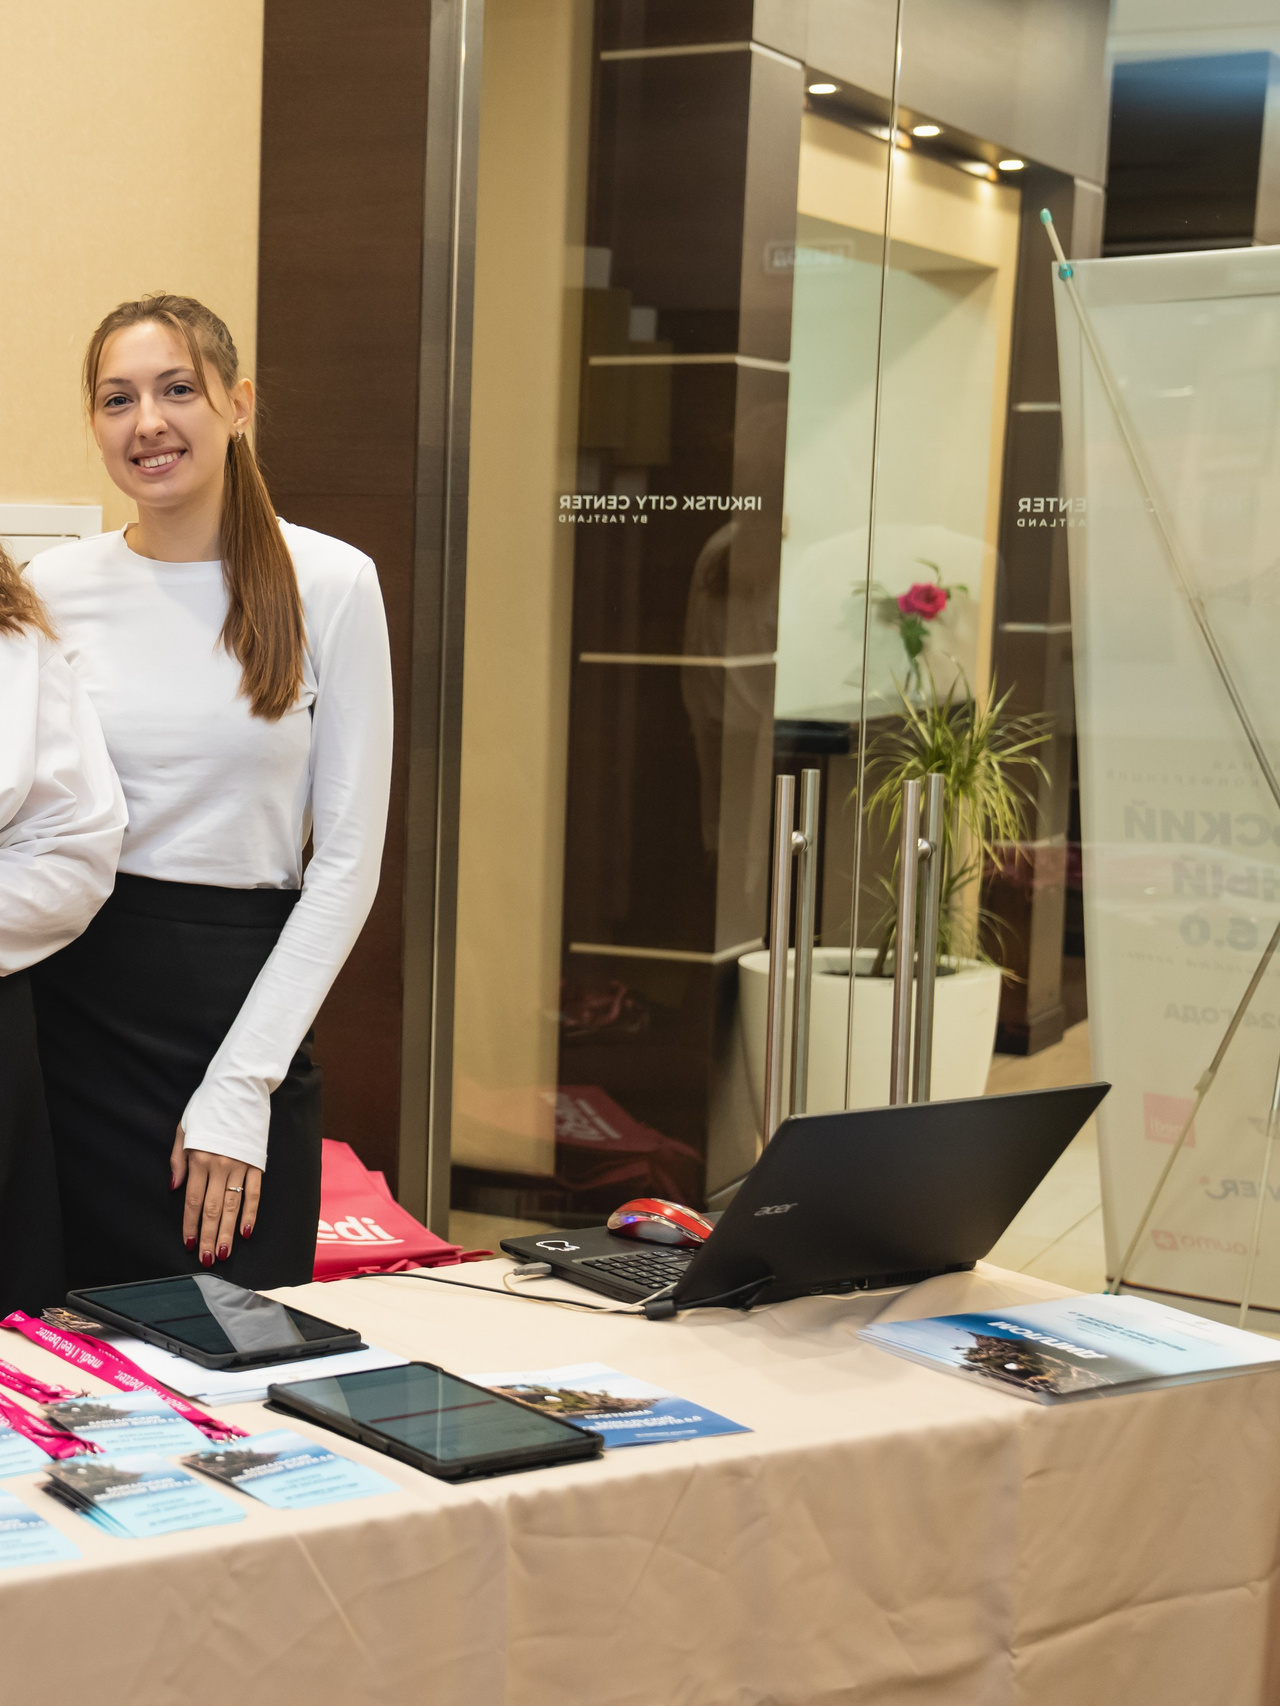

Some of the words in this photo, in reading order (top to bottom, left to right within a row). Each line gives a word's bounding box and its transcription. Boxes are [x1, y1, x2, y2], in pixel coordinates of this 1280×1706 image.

[754, 1203, 798, 1216] acer
[317, 1215, 396, 1241] edi
[35, 1326, 61, 1351] better.
[56, 1338, 76, 1358] feel
[987, 1321, 1108, 1359] ДИПЛОМ
[71, 1347, 81, 1359] I
[76, 1349, 104, 1370] medi.
